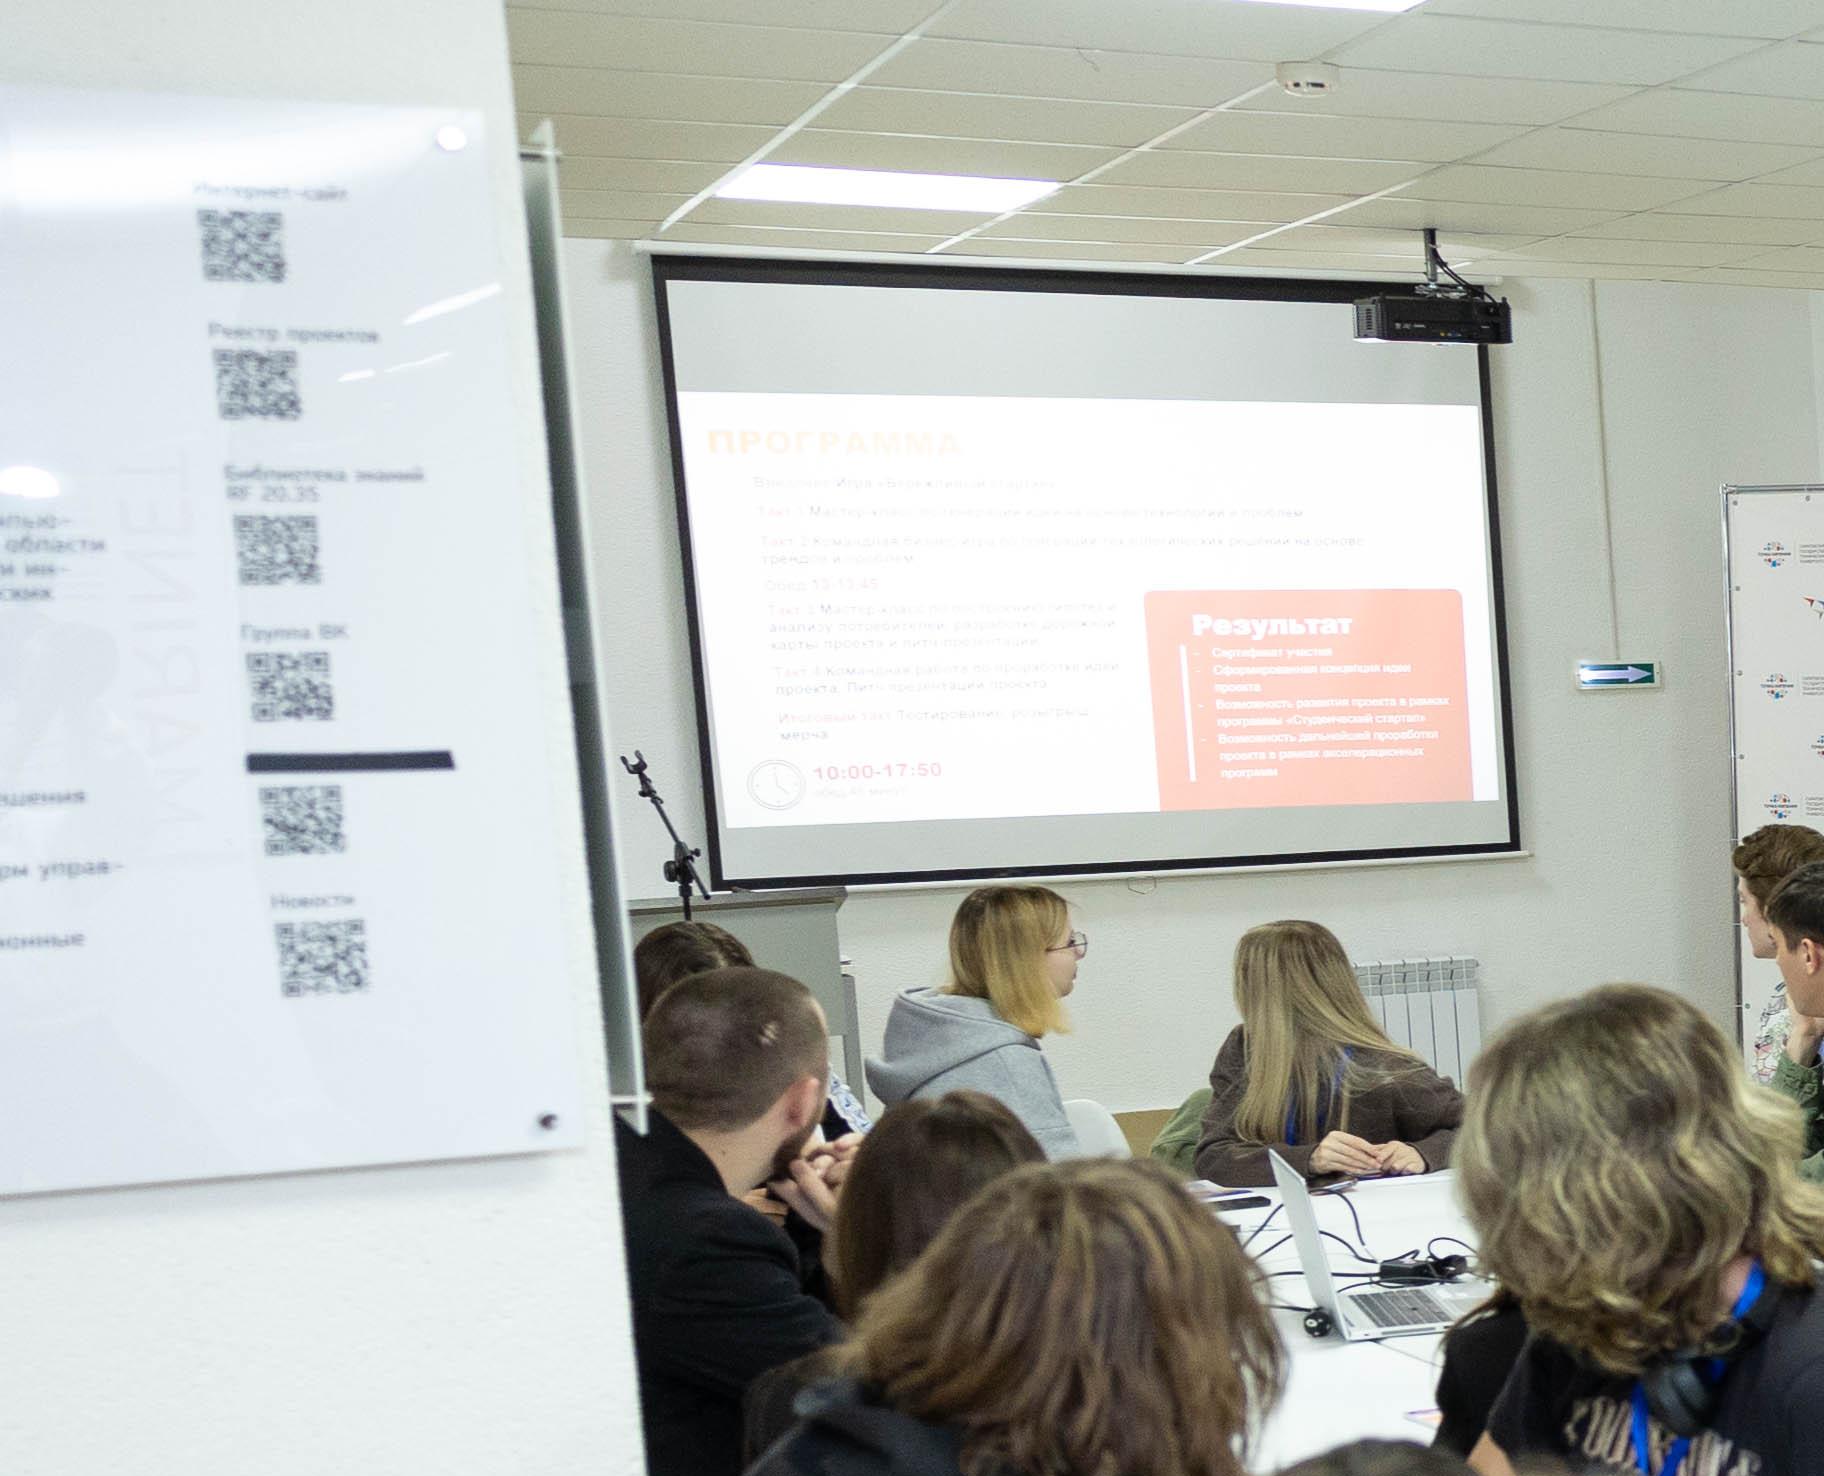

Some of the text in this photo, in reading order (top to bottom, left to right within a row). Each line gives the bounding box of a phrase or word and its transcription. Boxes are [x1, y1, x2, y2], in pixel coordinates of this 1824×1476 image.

[705, 429, 962, 457] ПРОГРАММА
[4, 535, 106, 552] области
[240, 623, 348, 643] Группа ВК
[1191, 613, 1353, 641] Результат
[813, 760, 943, 781] 10:00-17:50
[270, 895, 355, 910] Новости
